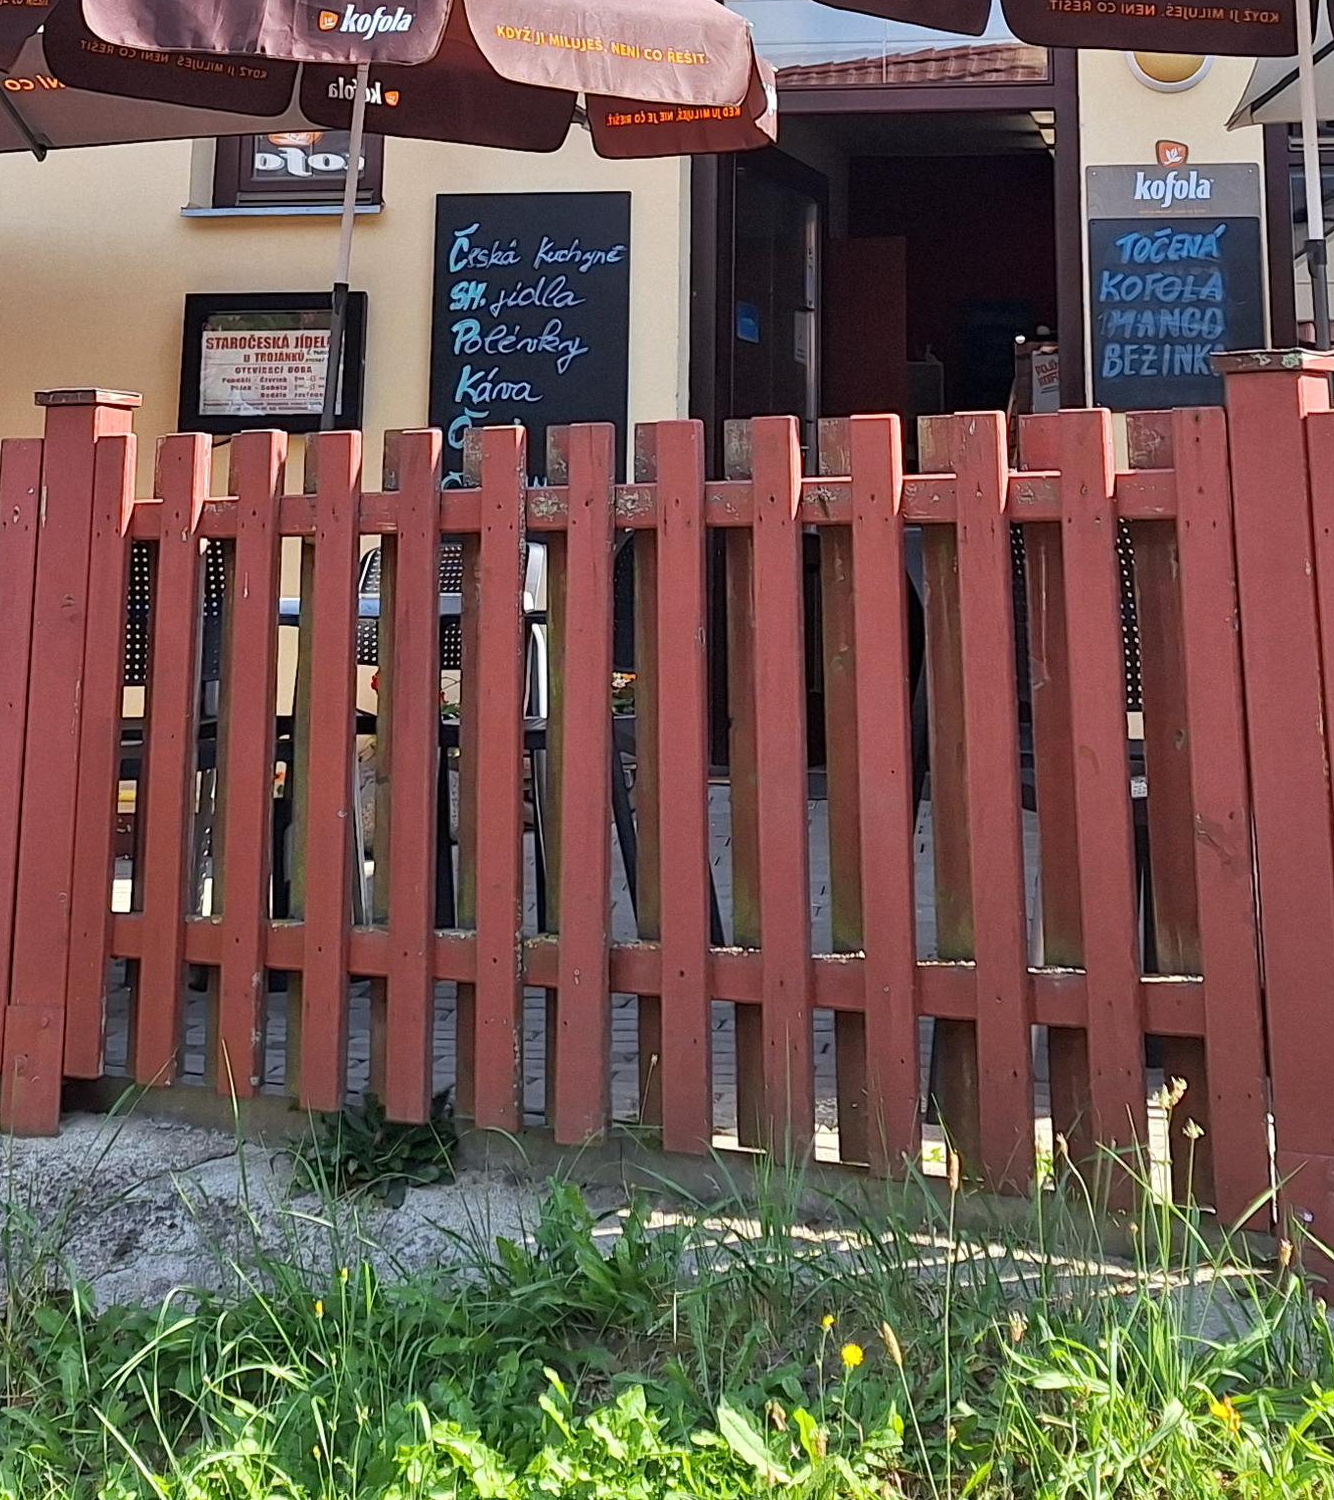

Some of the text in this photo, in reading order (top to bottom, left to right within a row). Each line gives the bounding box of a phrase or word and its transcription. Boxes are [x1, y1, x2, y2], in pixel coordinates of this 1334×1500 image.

[339, 3, 413, 41] kofola
[496, 25, 531, 42] KDYŽ
[534, 30, 545, 46] JI
[610, 41, 641, 59] NENÍ
[643, 48, 663, 61] CO
[1134, 171, 1211, 208] kofola
[449, 223, 520, 273] Česká
[1116, 223, 1227, 264] TOČENÁ
[1099, 270, 1224, 303] KOFOLA
[205, 333, 290, 350] STAROČESKÁ
[451, 318, 589, 374] Polévky
[455, 365, 544, 404] Káva
